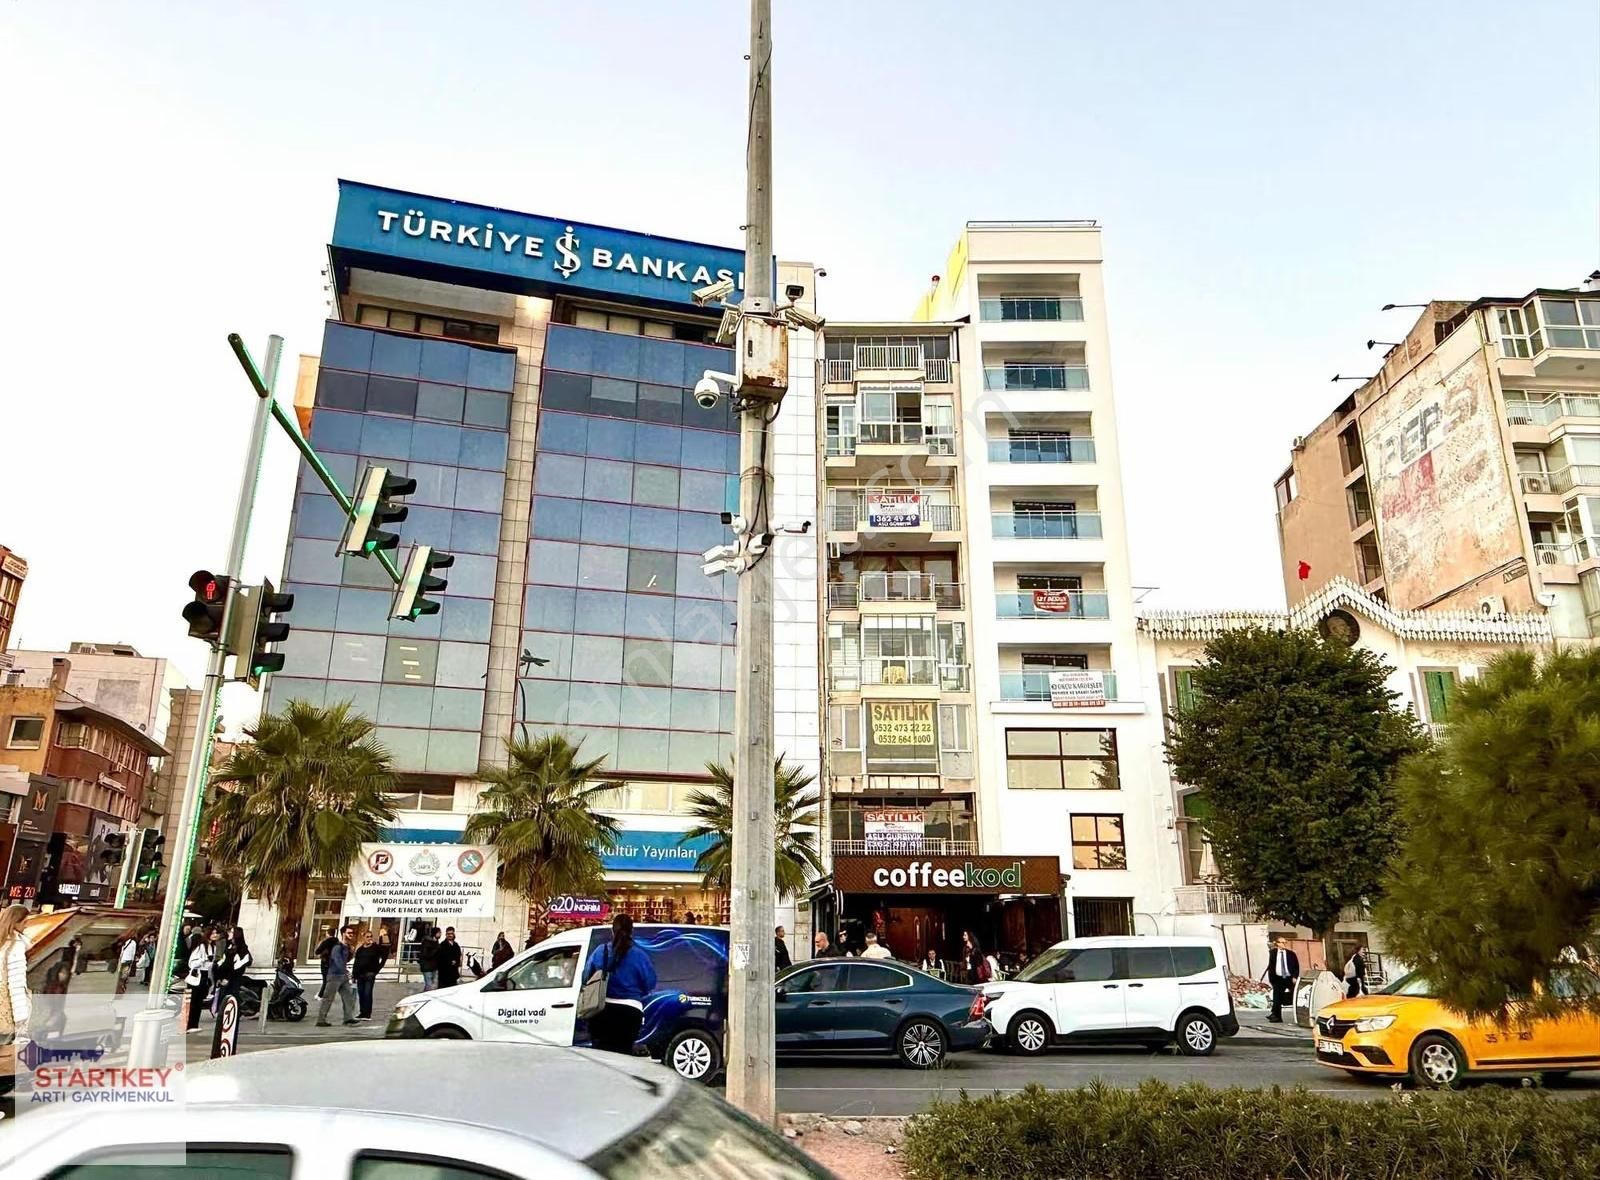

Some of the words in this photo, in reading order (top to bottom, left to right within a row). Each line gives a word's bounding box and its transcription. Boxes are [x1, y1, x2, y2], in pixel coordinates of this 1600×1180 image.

[377, 209, 544, 258] TÜRKİYE
[592, 248, 745, 290] BANKASI
[873, 495, 914, 503] SATILIK
[873, 704, 930, 721] SATILIK
[874, 723, 893, 732] 0532
[893, 723, 909, 732] 473
[910, 723, 920, 732] 22
[921, 723, 932, 732] 22
[878, 734, 897, 744] 0532
[866, 812, 922, 822] SATILIK
[642, 845, 697, 860] Yayınları
[873, 861, 1022, 888] coffeekod
[497, 1007, 526, 1018] Digital
[528, 1007, 547, 1017] vadi
